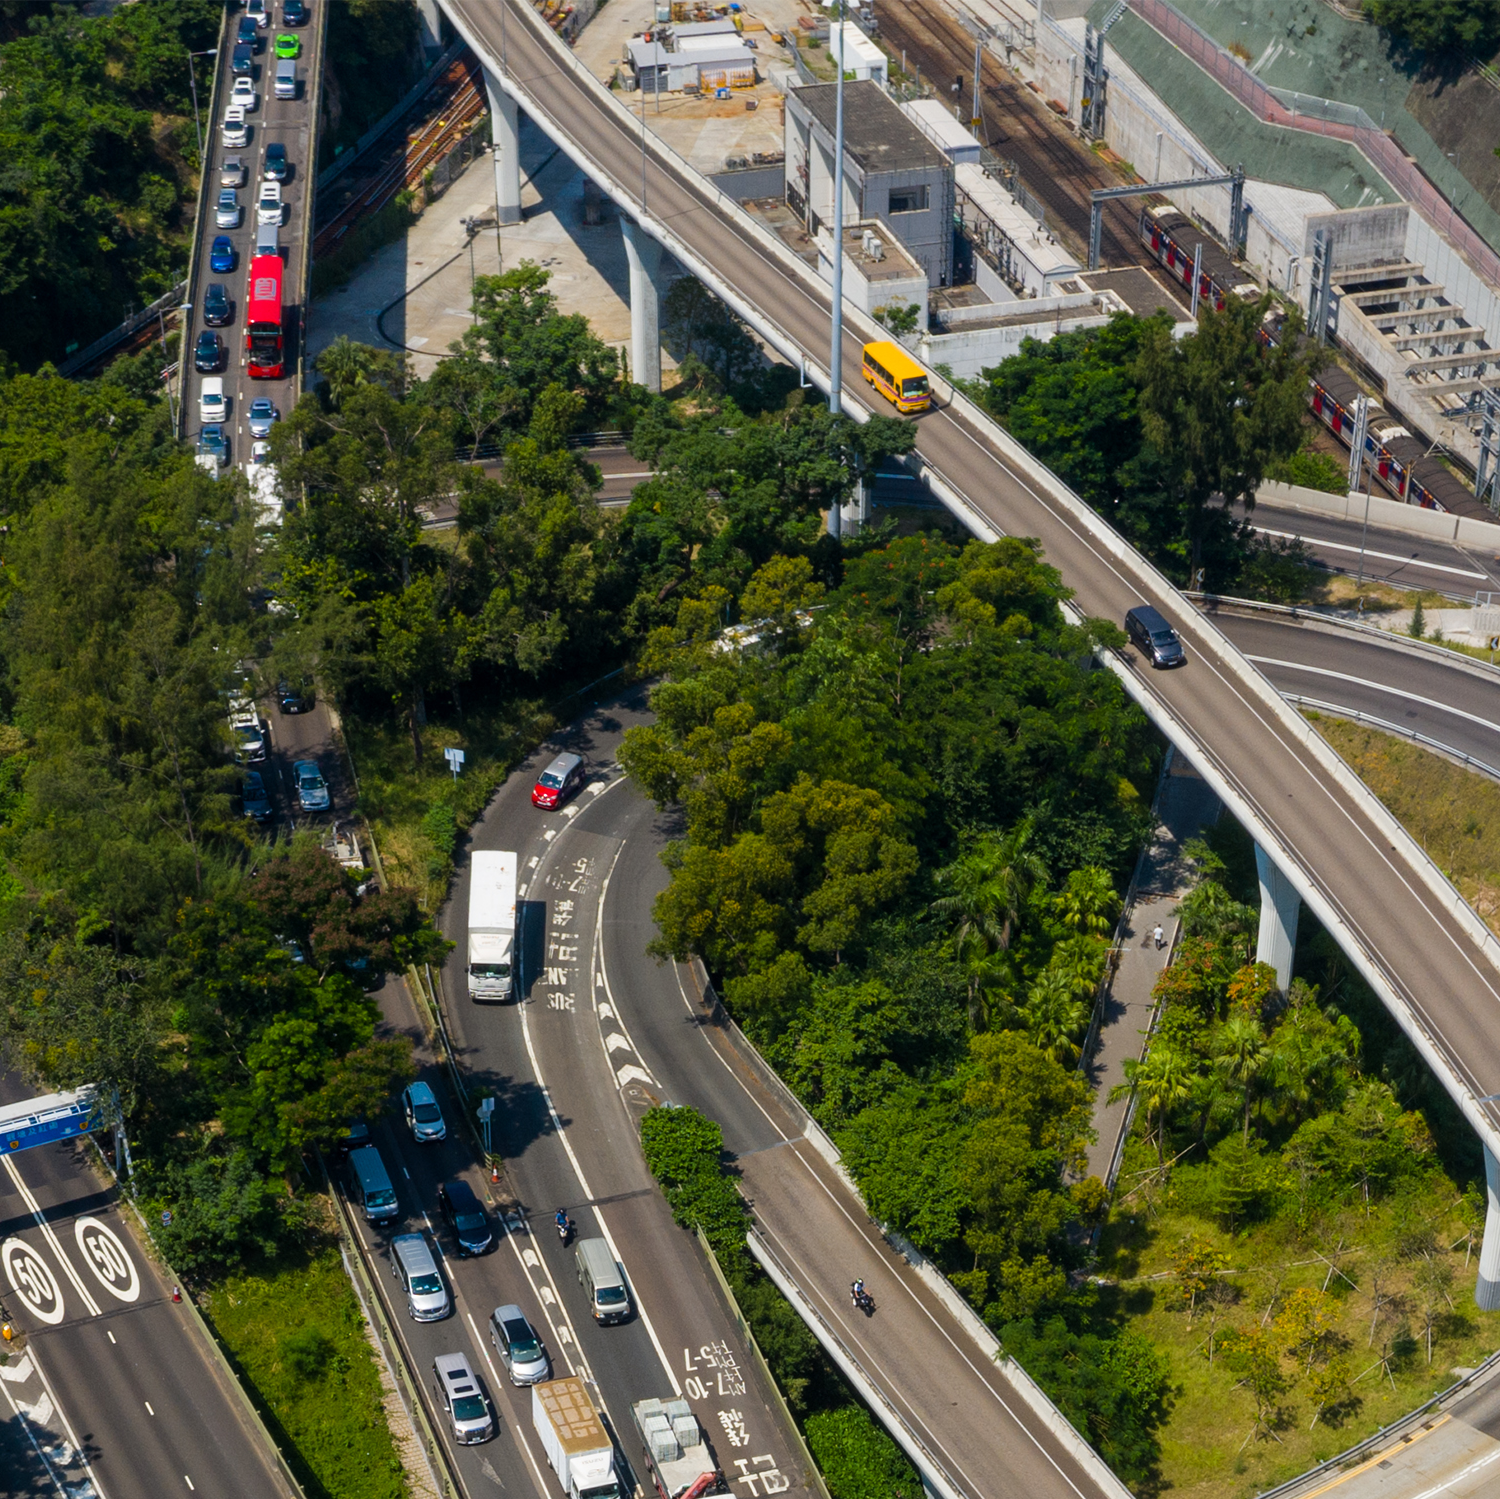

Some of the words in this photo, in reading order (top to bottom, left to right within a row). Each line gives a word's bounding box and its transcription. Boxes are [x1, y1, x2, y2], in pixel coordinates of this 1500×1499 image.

[85, 1234, 128, 1283] 50
[11, 1256, 54, 1305] 50
[684, 1345, 717, 1372] 5-7
[718, 1354, 736, 1369] PM
[685, 1372, 730, 1401] 7-10
[725, 1366, 745, 1383] 上午
[731, 1380, 746, 1396] AM
[581, 1457, 603, 1465] ISUZU
[733, 1454, 790, 1498] 巴士
